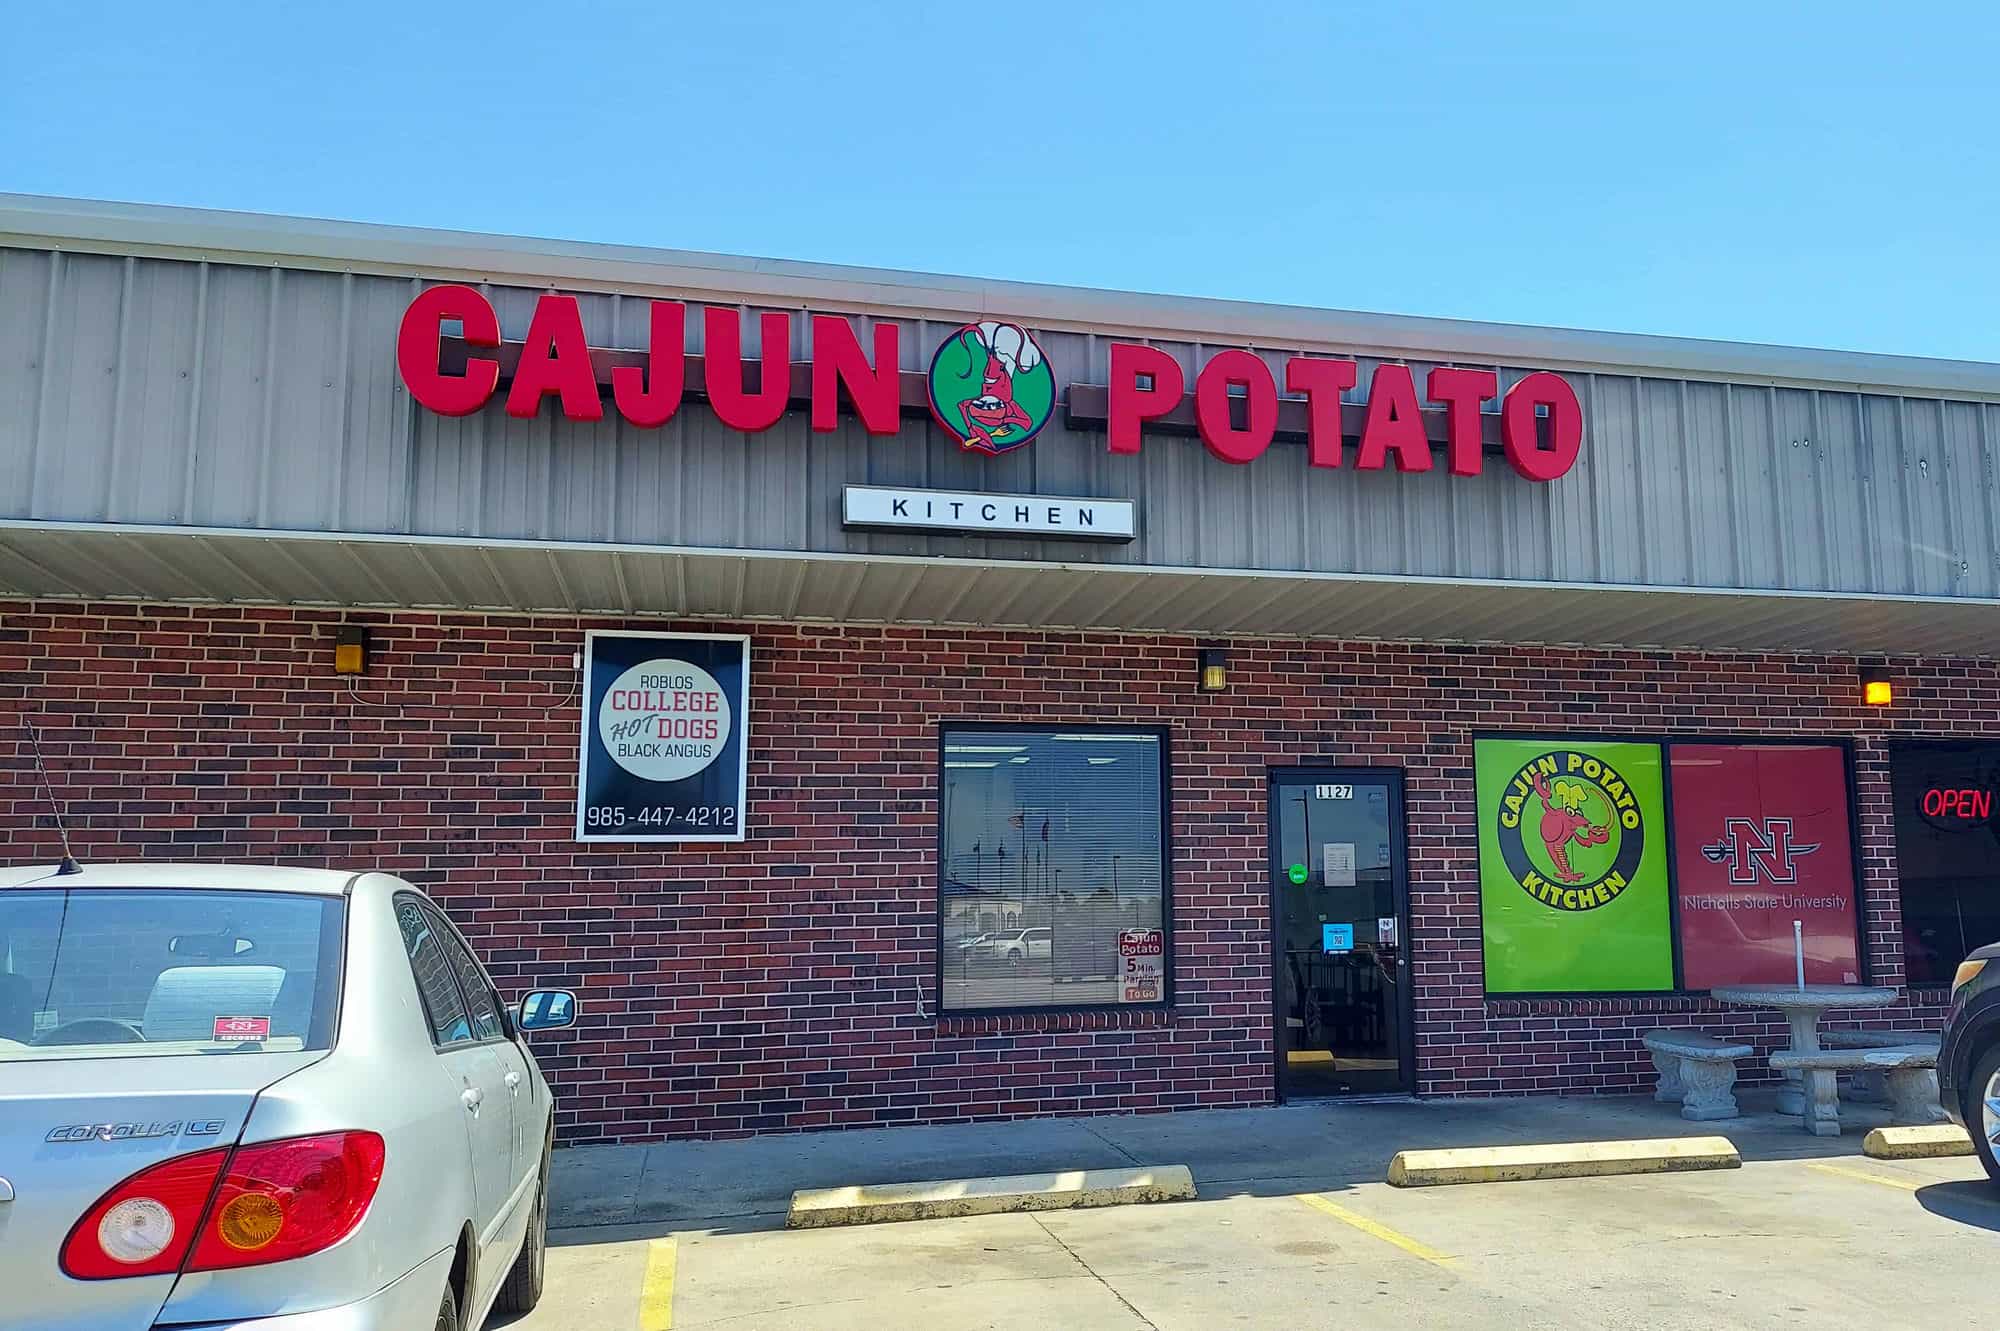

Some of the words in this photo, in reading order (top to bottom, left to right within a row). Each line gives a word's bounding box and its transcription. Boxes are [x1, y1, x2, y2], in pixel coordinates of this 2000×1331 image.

[397, 284, 901, 435] CAJUN
[1106, 341, 1583, 482] POTATO
[892, 499, 1094, 526] KITCHEN
[640, 674, 694, 690] ROBLOS
[612, 690, 719, 712] COLLEGE
[610, 714, 660, 742] HOT
[657, 718, 718, 739] DOGS
[617, 743, 662, 758] BLACK
[664, 743, 712, 759] ANGUS
[1318, 786, 1351, 798] 1127
[1567, 753, 1640, 830] POTATO
[1923, 789, 1991, 819] OPEN
[587, 806, 735, 827] 985-447-4212
[1522, 870, 1627, 909] KITCHEN
[1684, 893, 1740, 910] Nicholls
[1744, 894, 1778, 909] State
[1782, 893, 1848, 911] University
[1121, 944, 1160, 954] Potato
[1127, 957, 1136, 972] 5
[1128, 989, 1140, 999] To
[45, 1120, 181, 1143] COROLLA
[184, 1118, 226, 1135] LE
